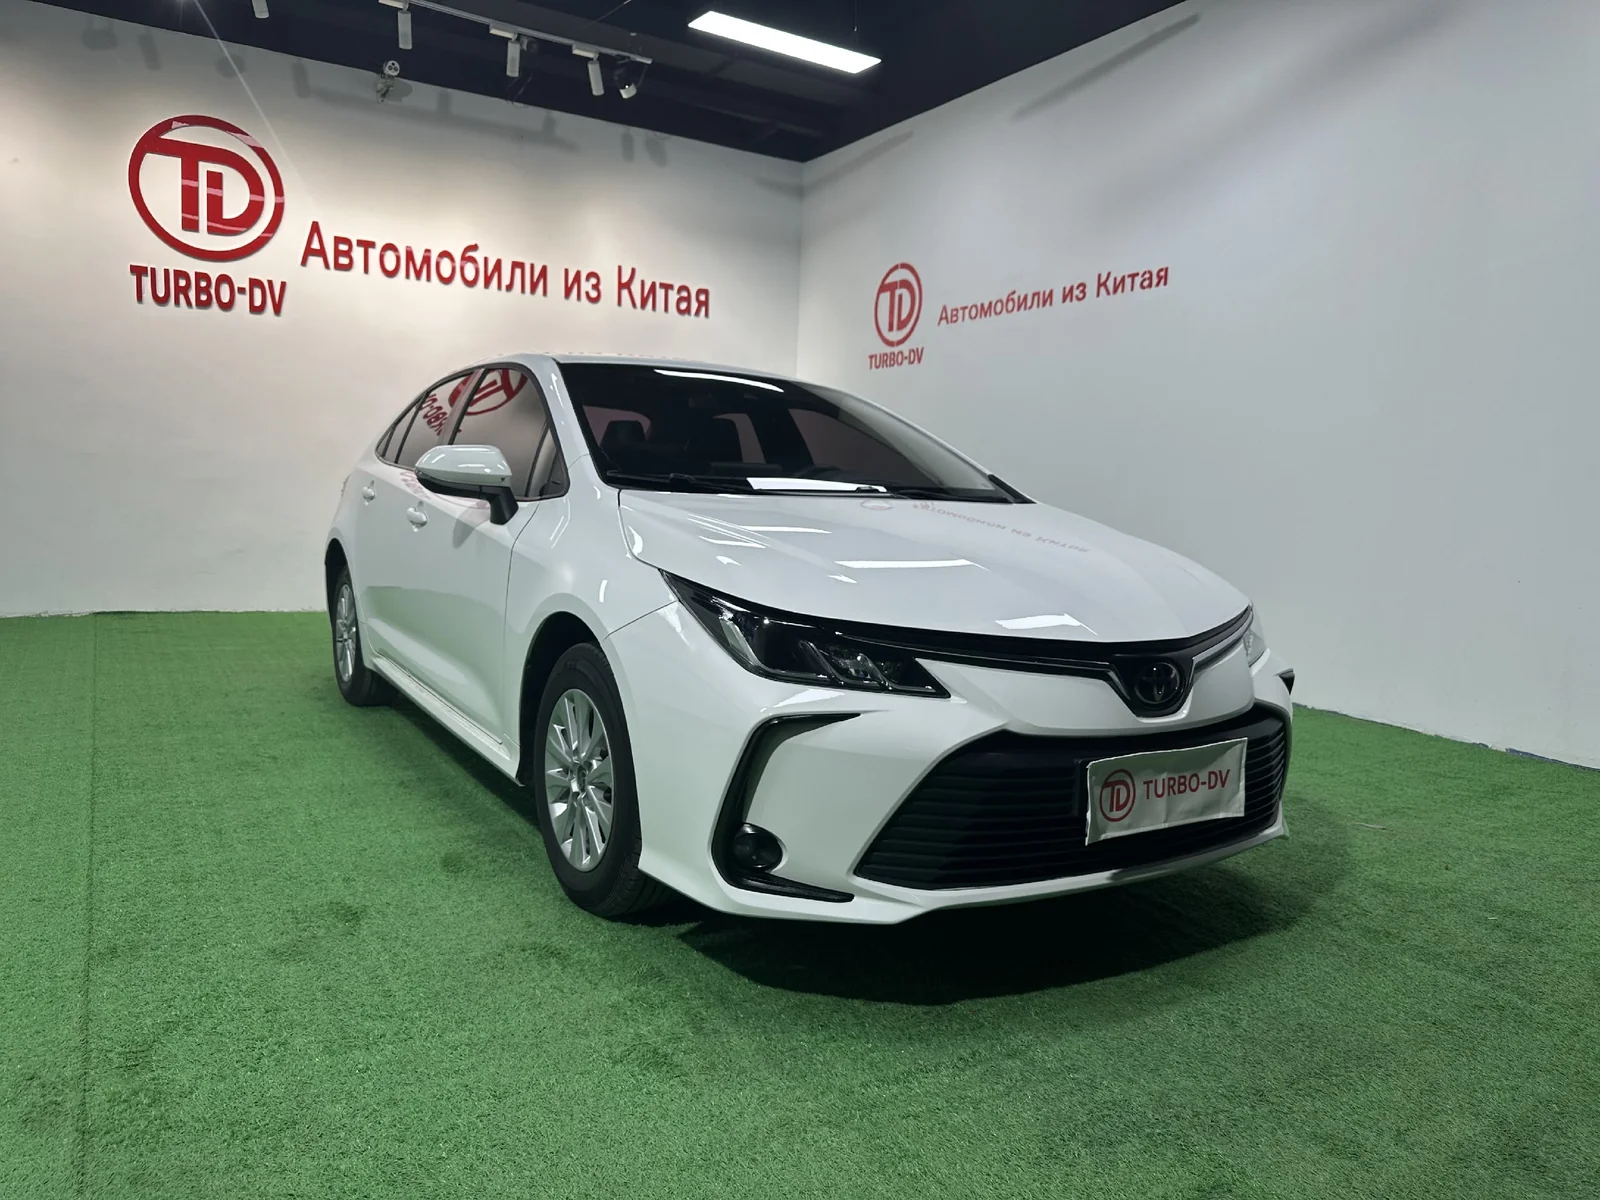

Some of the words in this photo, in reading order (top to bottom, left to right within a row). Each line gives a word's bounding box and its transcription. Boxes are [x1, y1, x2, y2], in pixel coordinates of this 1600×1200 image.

[129, 264, 287, 316] TURBO-DV
[300, 219, 550, 297] Автомобили
[562, 266, 603, 304] из
[615, 264, 711, 317] Китая
[937, 288, 1054, 326] Автомобили
[1061, 281, 1087, 304] из
[1095, 266, 1169, 297] Китая
[868, 346, 925, 370] TURBO-DV
[1143, 768, 1231, 800] TURBO-DV
